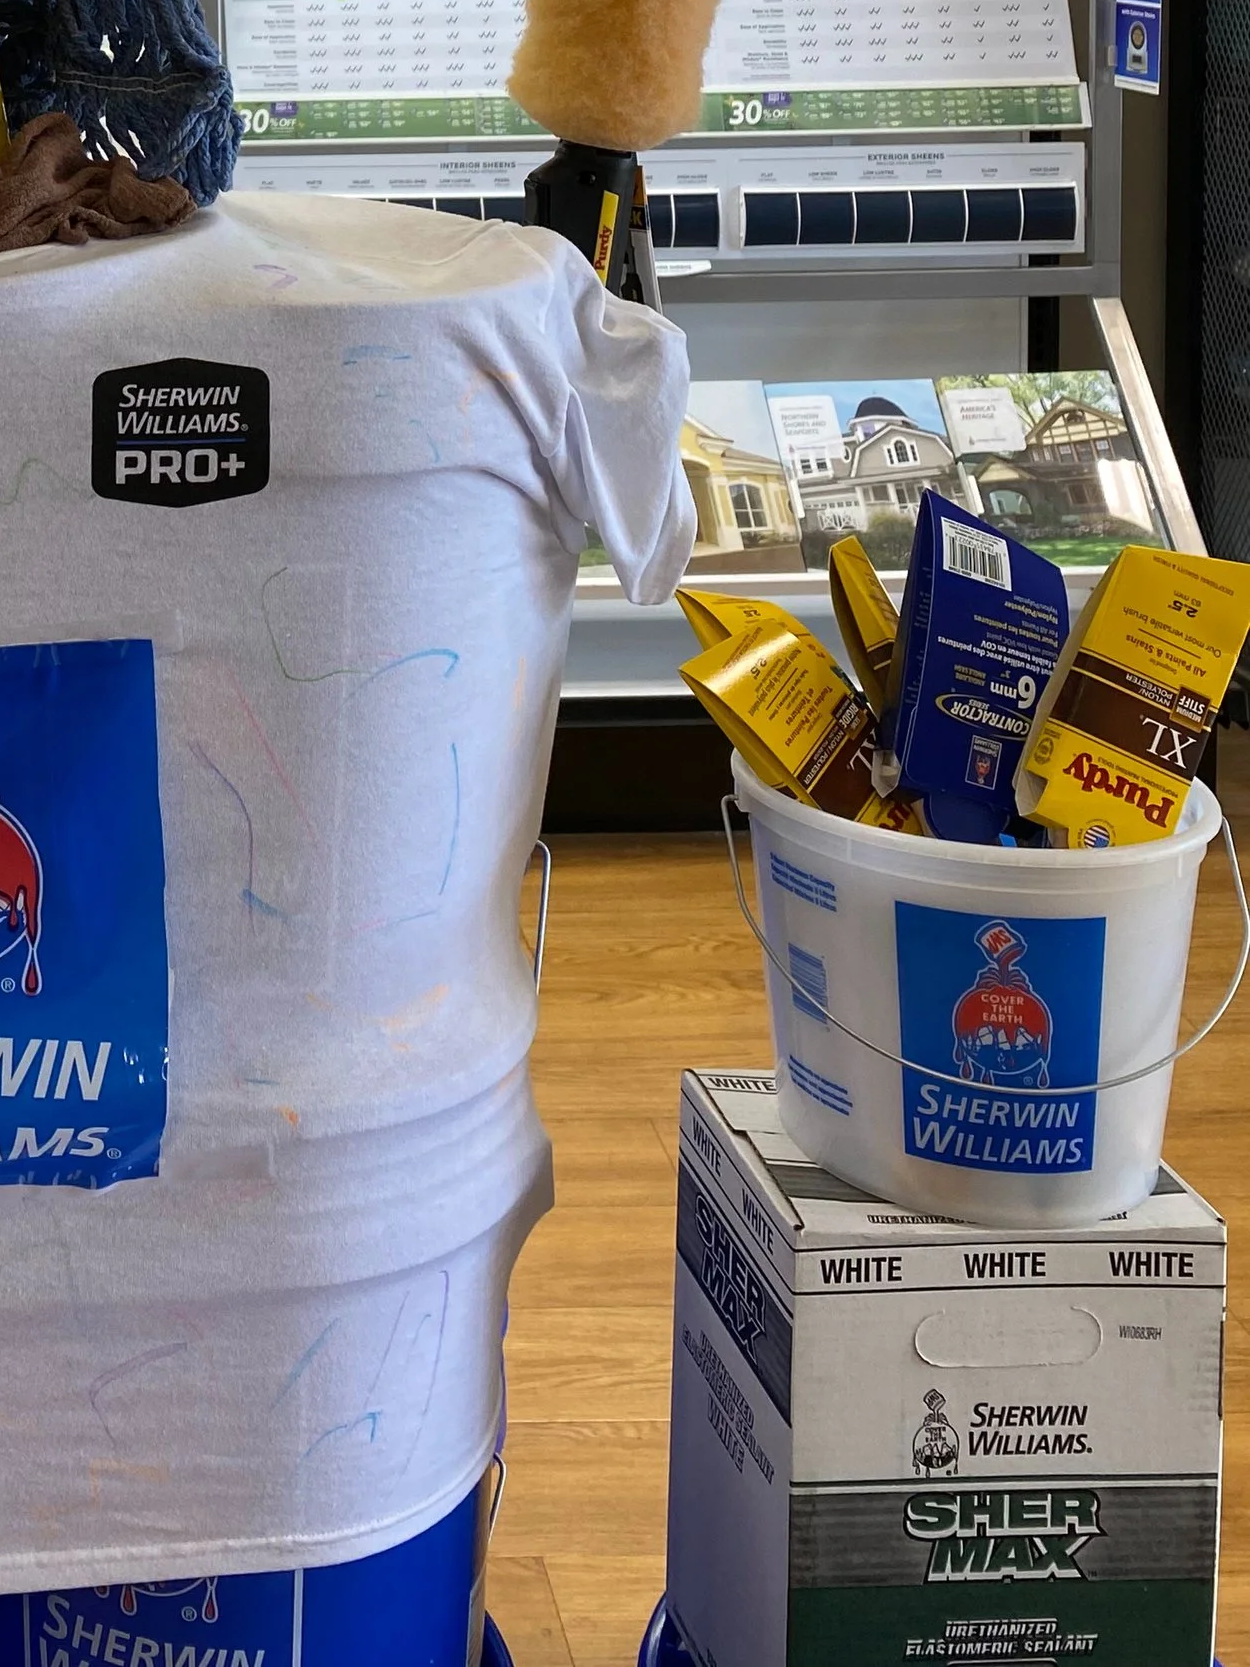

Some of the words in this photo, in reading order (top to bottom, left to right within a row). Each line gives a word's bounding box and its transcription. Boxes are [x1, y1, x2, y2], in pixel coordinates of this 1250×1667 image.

[729, 99, 762, 125] 30
[440, 161, 480, 170] INTERIOR
[483, 161, 516, 169] SHEENS
[867, 153, 909, 162] EXTERIOR
[911, 152, 945, 161] SHEENS
[594, 224, 612, 271] Purdy
[118, 382, 241, 410] SHERWIN
[114, 449, 246, 488] PRO+
[1123, 606, 1148, 631] brush
[1150, 616, 1185, 642] versatile
[1125, 634, 1155, 655] Stains
[1184, 633, 1205, 650] most
[1204, 641, 1223, 659] Our
[1163, 651, 1193, 673] Paints
[1192, 664, 1207, 678] All
[1125, 673, 1174, 700] POLYESTER
[1138, 686, 1171, 708] NYLON/
[950, 700, 1031, 735] CONTRACTOR
[1175, 706, 1203, 724] MEDIUM
[1178, 694, 1206, 716] STIFF
[1142, 717, 1197, 770] XL
[1063, 752, 1176, 829] Purdy
[981, 994, 1024, 1006] COVER
[991, 1004, 1016, 1015] THE
[982, 1012, 1024, 1024] EARTH
[708, 1077, 775, 1092] WHITE
[916, 1084, 1080, 1129] SHERWIN
[692, 1116, 722, 1176] WHITE
[912, 1117, 1084, 1166] WILLIAMS
[742, 1187, 775, 1255] WHITE
[821, 1256, 902, 1283] WHITE
[964, 1252, 1046, 1278] WHITE
[1109, 1251, 1194, 1278] WHITE
[970, 1402, 1088, 1428] SHERWIN
[707, 1393, 744, 1474] WHITE
[905, 1491, 1104, 1539] SHER
[925, 1535, 1093, 1582] MAX
[945, 1620, 1058, 1638] URETHANIZED
[905, 1639, 1019, 1657] ELASTOMERIC
[1024, 1634, 1099, 1654] SEALANT
